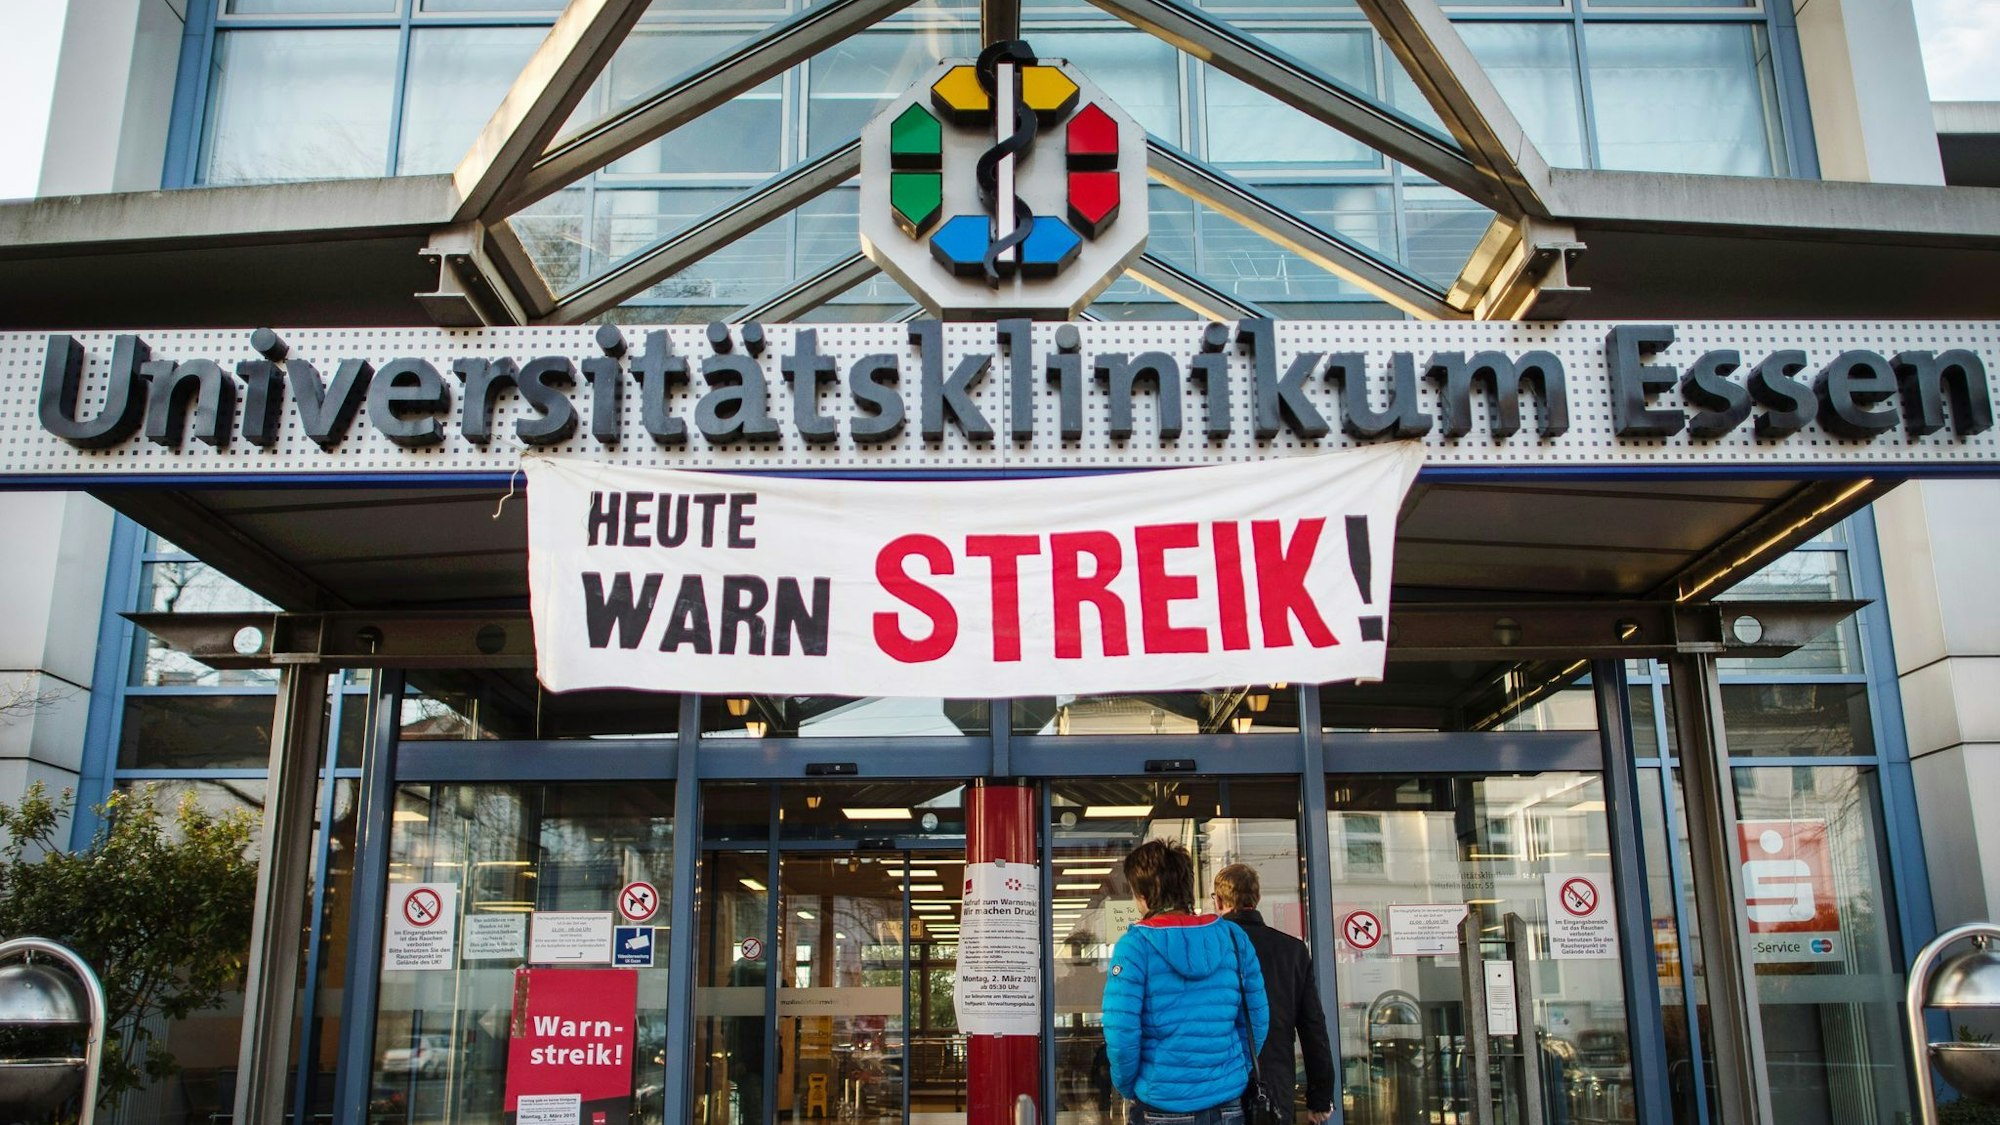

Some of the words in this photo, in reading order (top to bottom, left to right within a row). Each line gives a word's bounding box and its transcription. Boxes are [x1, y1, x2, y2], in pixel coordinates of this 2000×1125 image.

[38, 317, 1569, 452] Universitätsklinikum
[1605, 325, 1994, 440] Essen
[588, 491, 757, 549] HEUTE
[581, 571, 831, 657] WARN
[873, 514, 1384, 663] STREIK!
[975, 907, 1011, 915] machen
[962, 975, 989, 983] Montag,
[533, 1016, 623, 1037] Warn-
[530, 1043, 622, 1065] streik!
